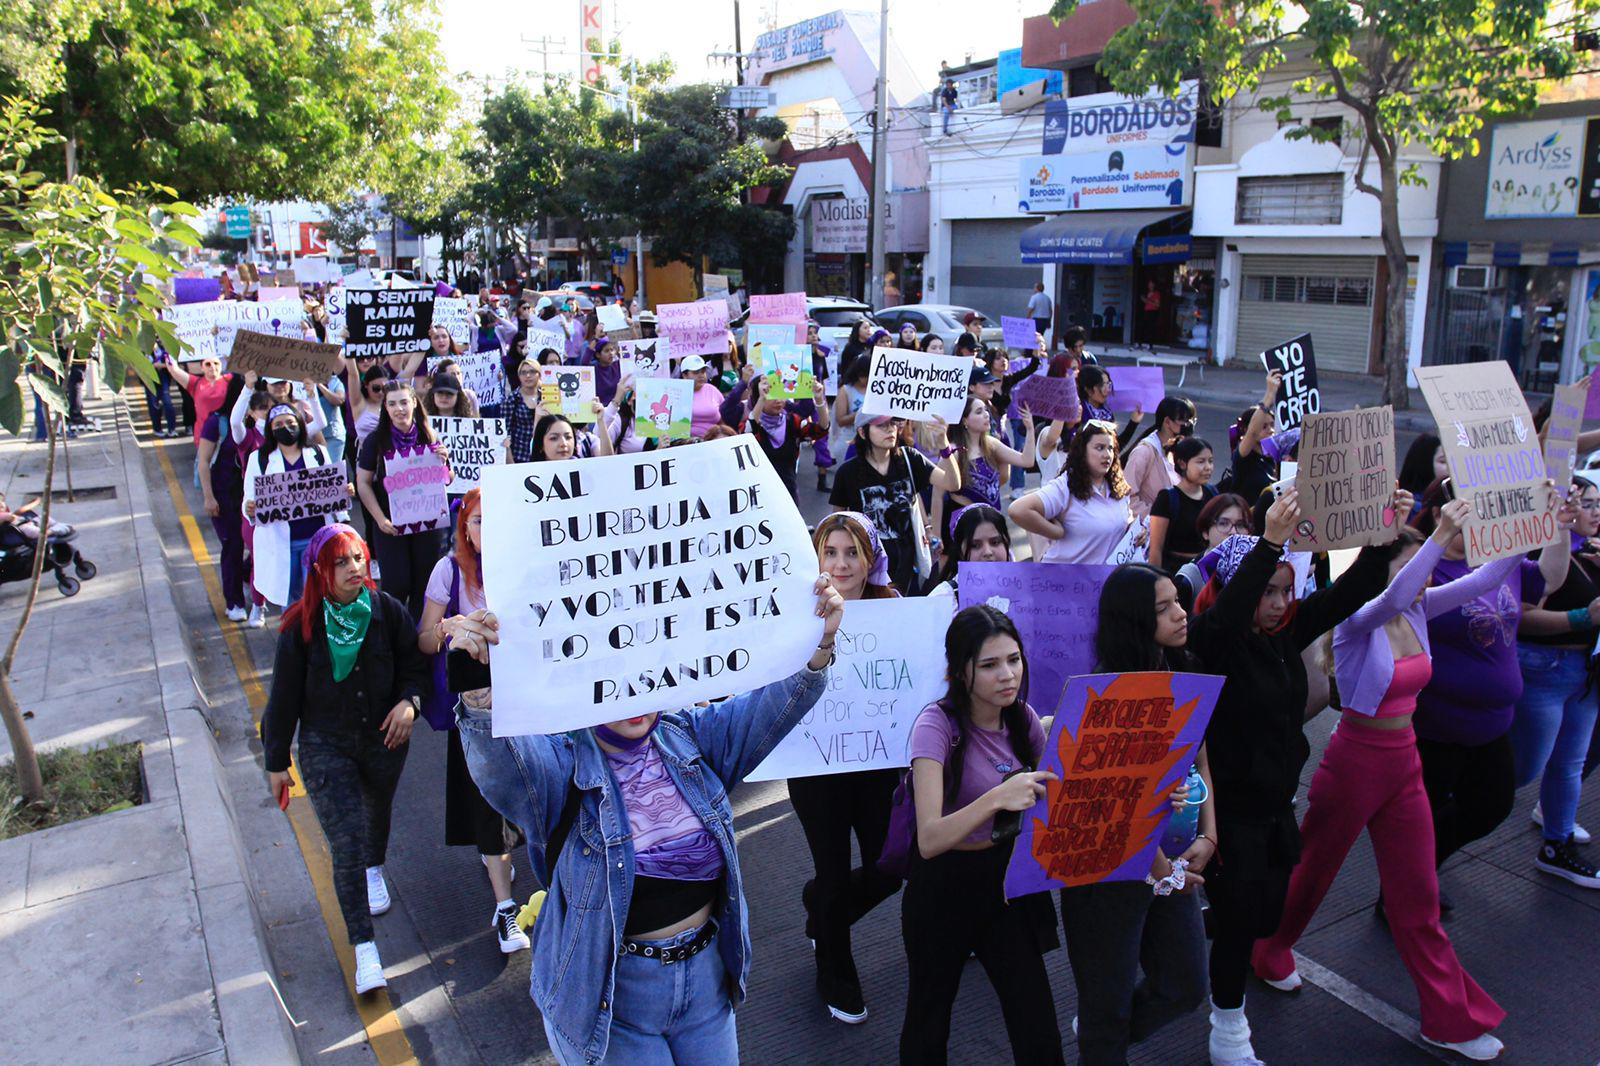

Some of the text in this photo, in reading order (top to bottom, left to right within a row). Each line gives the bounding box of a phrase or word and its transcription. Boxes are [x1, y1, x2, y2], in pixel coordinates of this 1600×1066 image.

[772, 46, 787, 62] DEL
[791, 34, 824, 57] PARQUE
[1070, 97, 1192, 138] BORDADOS
[1106, 131, 1148, 144] UNIFORMES
[1498, 141, 1572, 170] Ardyss
[1071, 170, 1180, 184] Personalizados Sublimado
[1081, 183, 1166, 195] Bordados Uniformes
[346, 292, 372, 305] NO
[377, 290, 434, 304] SENTIR
[661, 304, 714, 318] SOMOS LAS
[364, 306, 415, 320] RABIA
[699, 319, 710, 330] DE
[366, 324, 414, 338] ES UN
[682, 331, 691, 342] YA
[697, 331, 709, 340] NO
[346, 338, 431, 357] PRIVILEGIO
[1275, 342, 1303, 371] YO
[874, 353, 963, 383] Acostumbrarse
[1282, 367, 1307, 397] TE
[871, 378, 966, 400] es otra forma de
[1454, 388, 1497, 411] MOLESTA
[1499, 387, 1520, 408] MAS
[890, 397, 930, 412] morir
[432, 419, 448, 433] MI
[1302, 417, 1352, 448] MARCHO
[1469, 420, 1521, 450] UNA MUJER
[453, 466, 480, 481] ACOS
[523, 445, 760, 503] SAL DE TU
[1310, 442, 1383, 478] ESTOY VIVA
[1451, 448, 1544, 489] LUCHANDO
[255, 475, 344, 497] DE LAS MUJERES
[282, 473, 293, 482] LA
[1311, 483, 1320, 510] Y
[1360, 469, 1388, 500] HASTA
[255, 487, 339, 508] QUE NUNCA
[256, 499, 347, 524] VAS A TOCAR
[1474, 486, 1536, 522] QUE UN HOMBRE
[540, 484, 764, 547] BURBUJA DE
[1470, 511, 1555, 560] ACOSANDO
[558, 520, 773, 586] PRIVILEGIOS
[529, 553, 791, 627] Y VOLTEA A VER
[542, 588, 781, 663] LO QUE ESTÁ
[593, 648, 750, 704] PASANDO
[853, 658, 913, 690] VIEJA
[805, 722, 896, 767] "VIEJA"
[1047, 799, 1117, 832] LUCHAN
